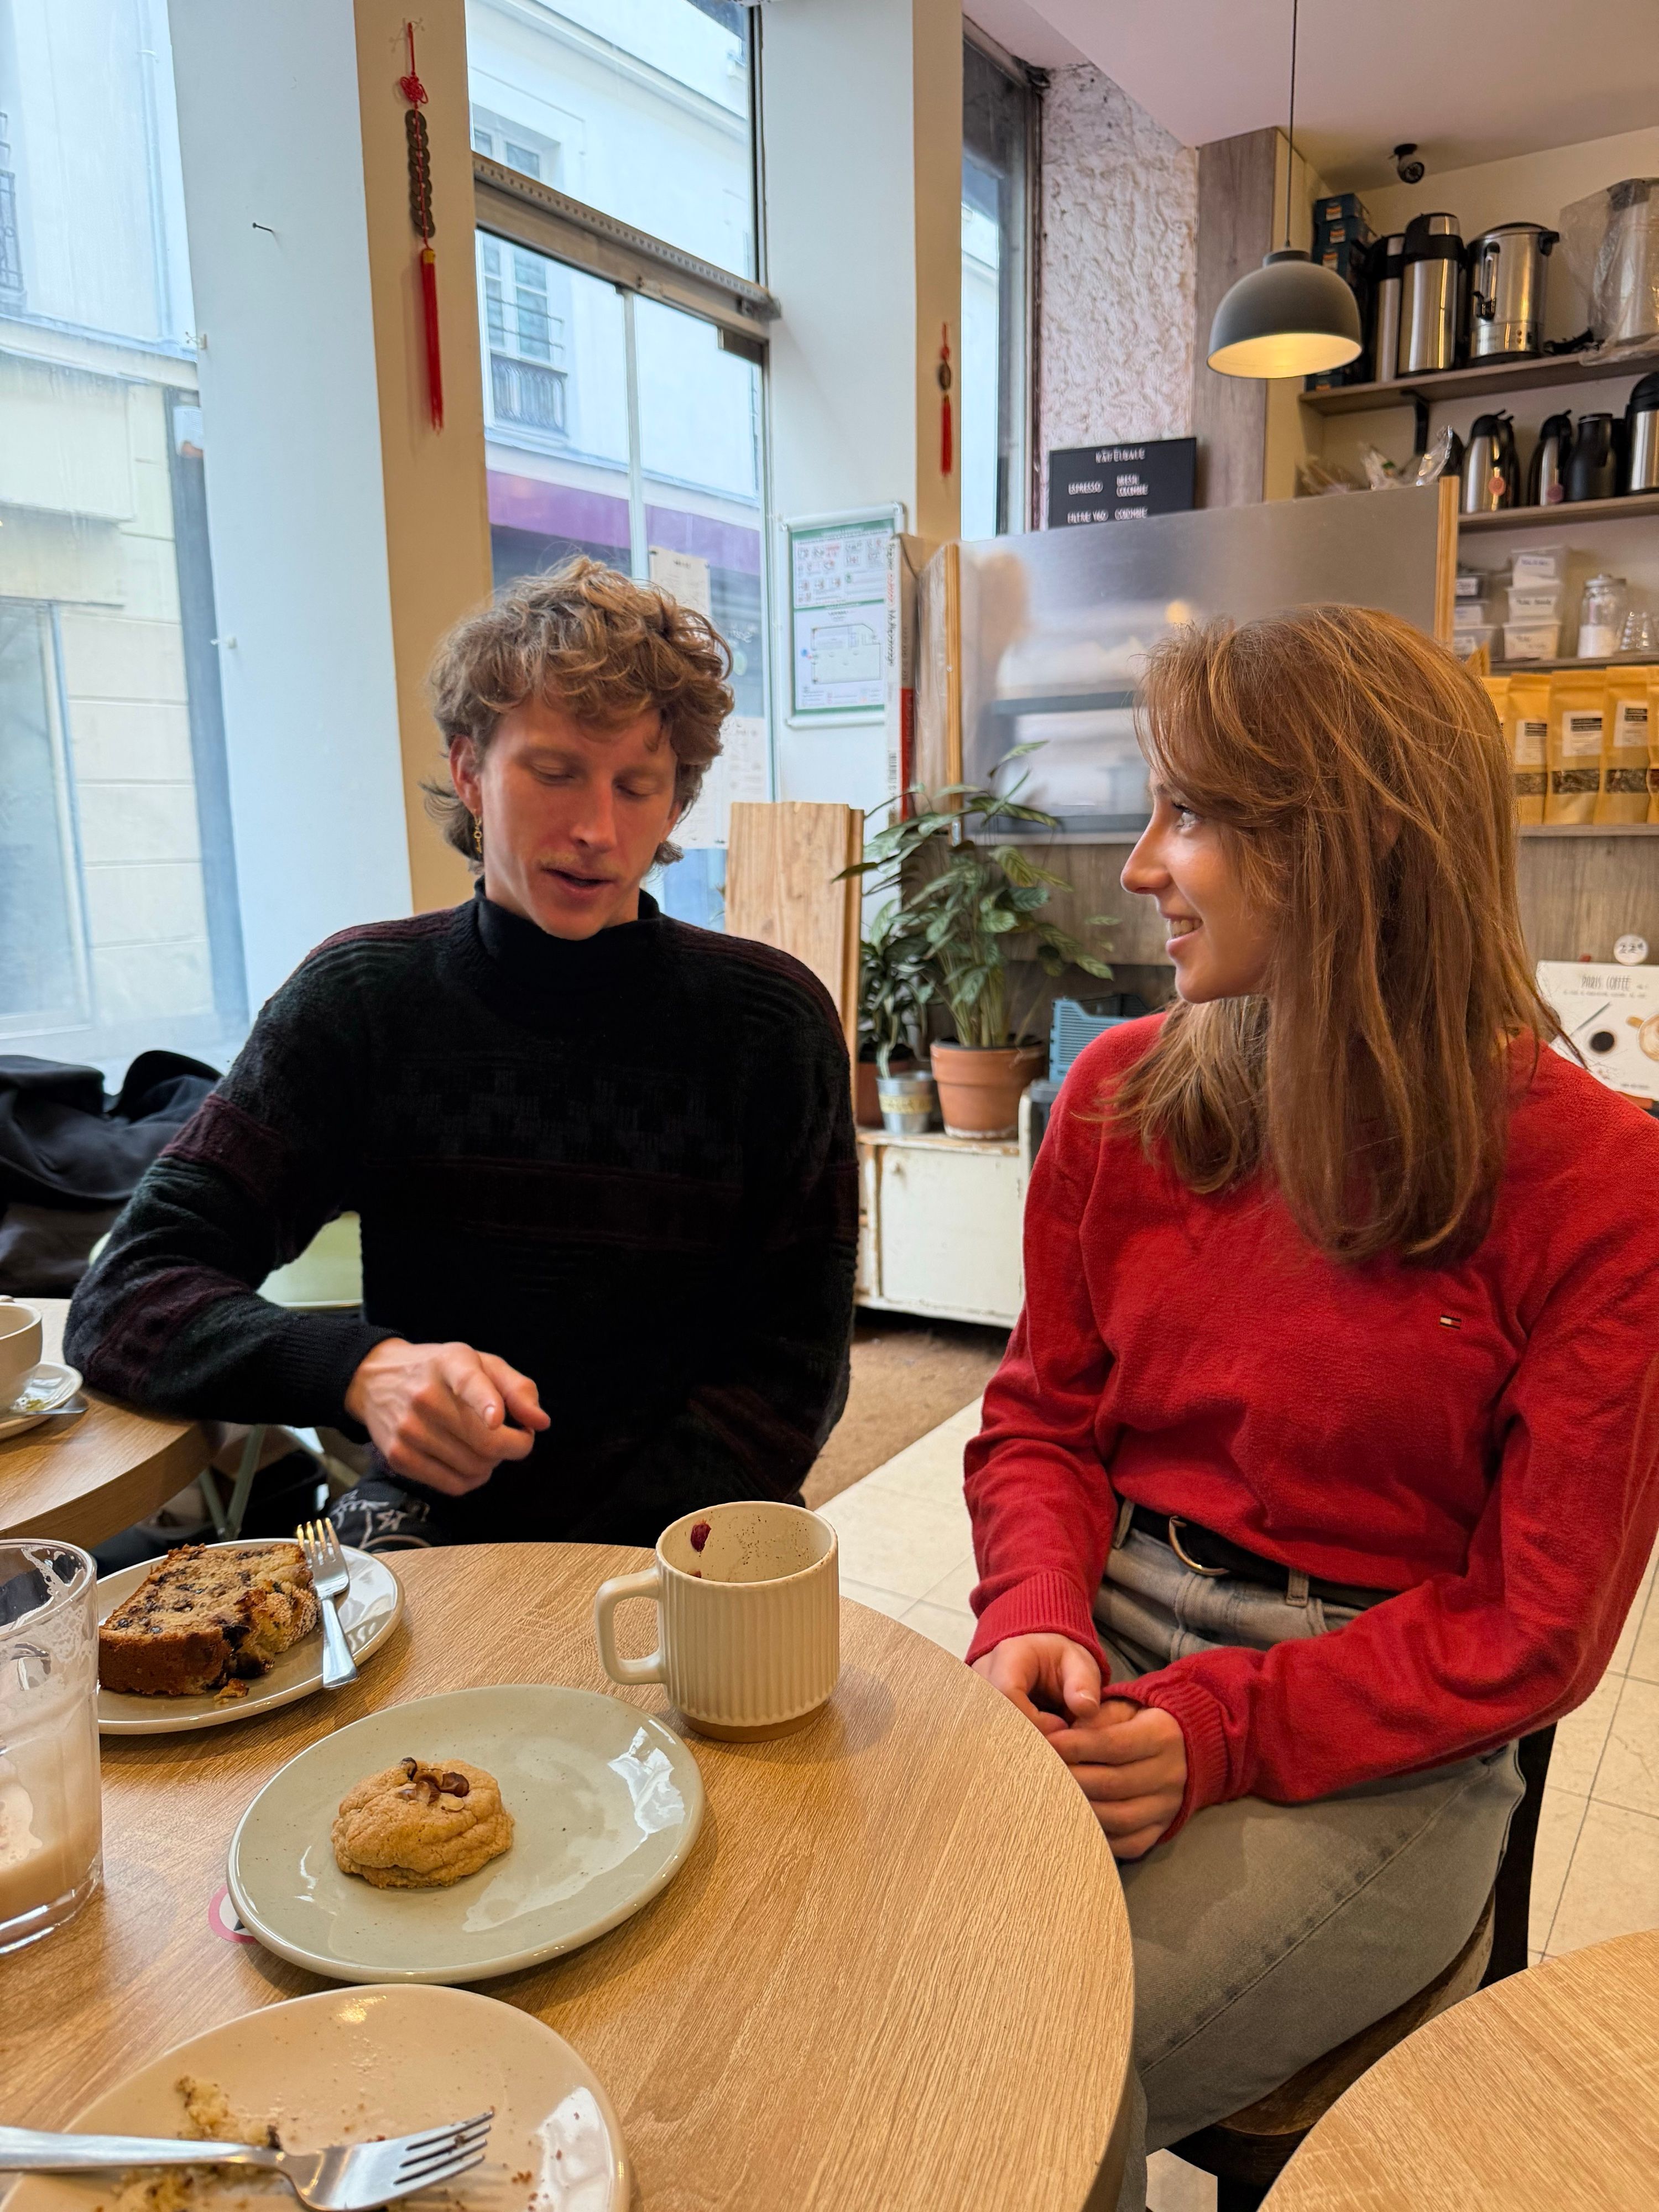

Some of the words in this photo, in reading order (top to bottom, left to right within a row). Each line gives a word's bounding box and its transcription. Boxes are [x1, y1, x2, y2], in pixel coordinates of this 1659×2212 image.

[1068, 481, 1103, 495] ESPRESSO
[1582, 975, 1601, 989] PARIS
[1606, 975, 1632, 991] COFFEE
